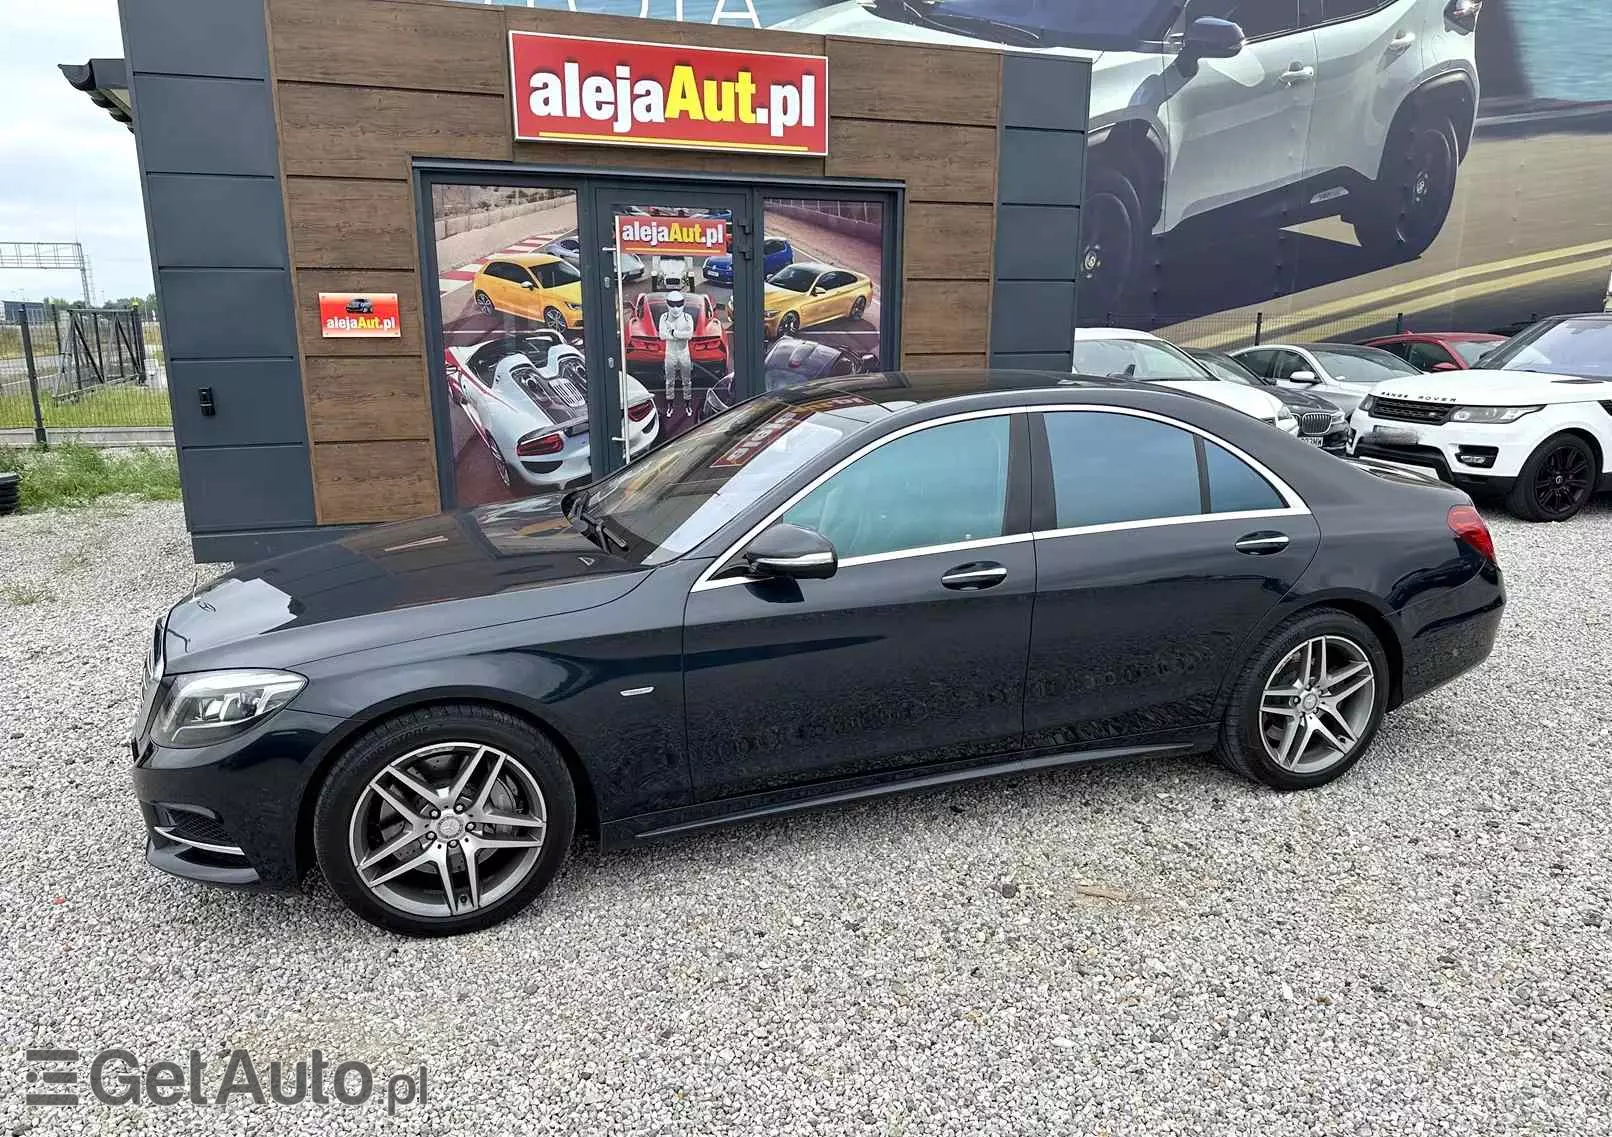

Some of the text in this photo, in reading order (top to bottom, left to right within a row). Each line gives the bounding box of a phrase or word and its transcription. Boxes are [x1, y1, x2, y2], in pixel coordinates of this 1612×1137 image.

[529, 61, 815, 137] alejaAut.pl
[622, 221, 723, 247] alejaAut.pl
[327, 316, 396, 331] alejaAut.pl
